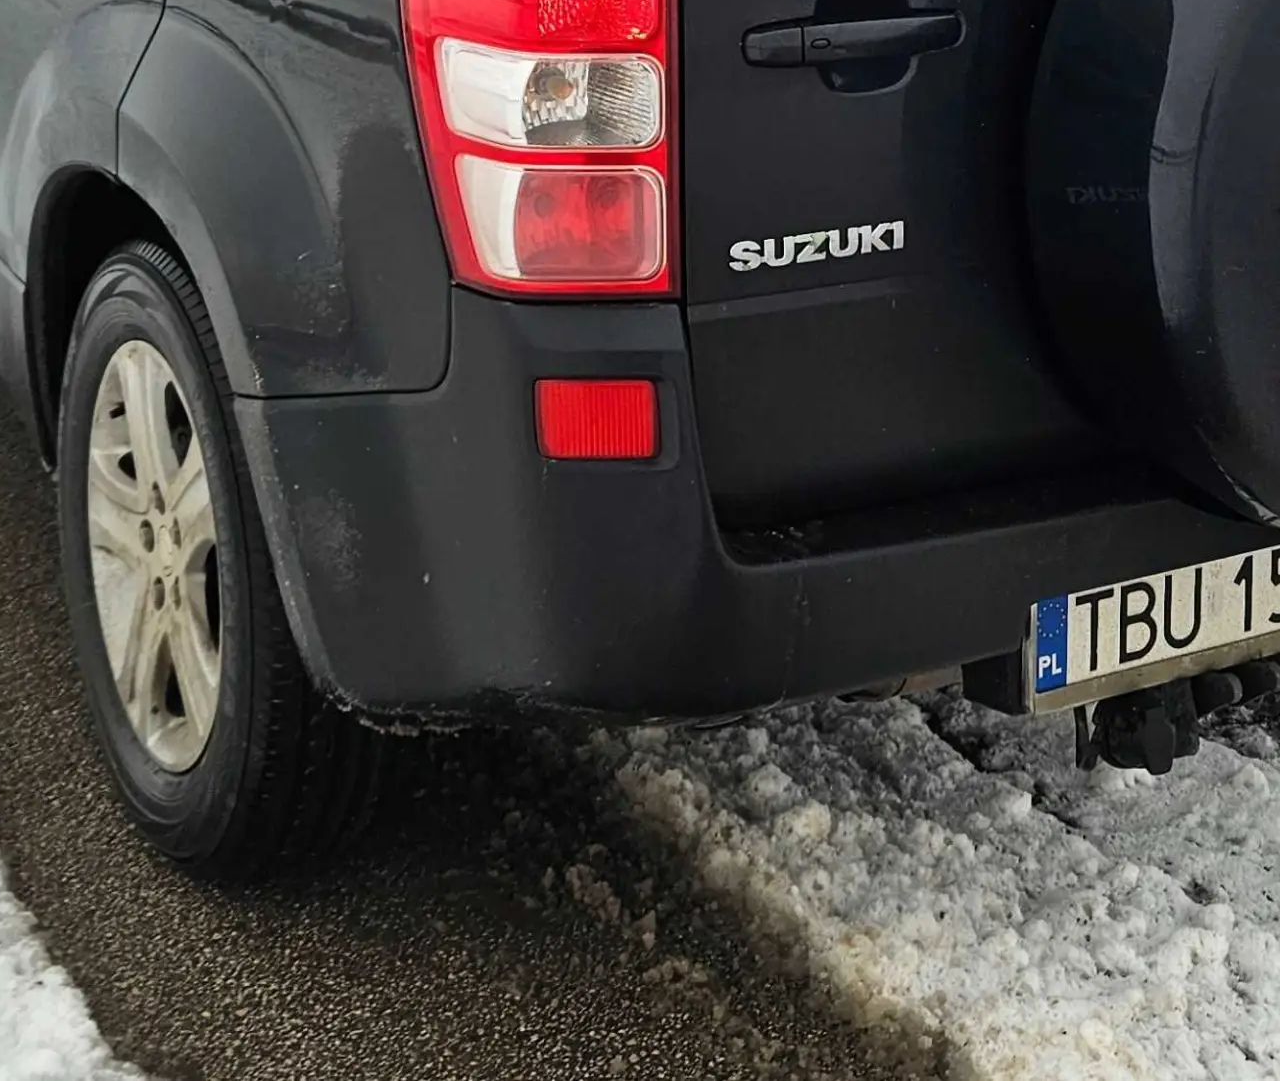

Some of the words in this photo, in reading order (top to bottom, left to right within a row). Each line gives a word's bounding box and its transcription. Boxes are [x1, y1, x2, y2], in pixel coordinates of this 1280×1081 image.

[728, 220, 904, 272] SUZUKI
[1075, 567, 1202, 672] TBU
[1038, 655, 1063, 678] PL
